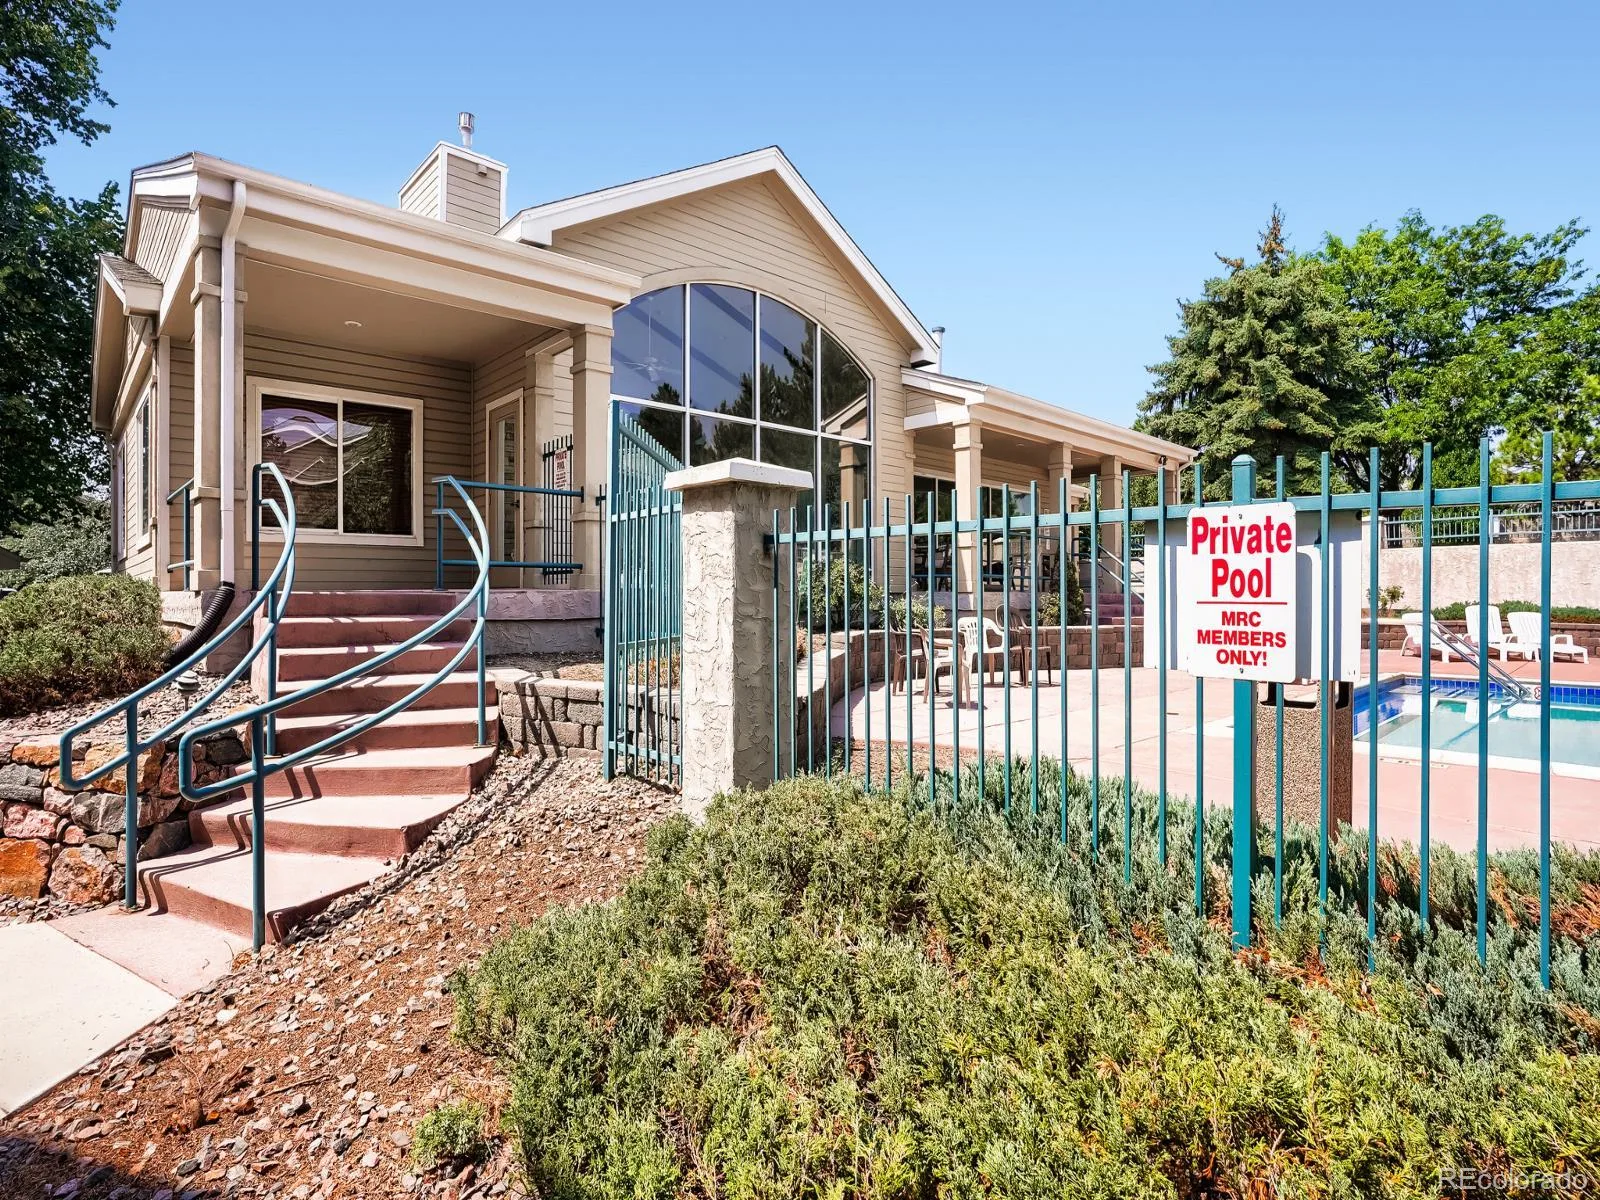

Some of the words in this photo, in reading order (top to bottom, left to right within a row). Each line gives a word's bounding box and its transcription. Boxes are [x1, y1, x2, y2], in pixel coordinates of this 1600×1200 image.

[1191, 515, 1292, 555] Private
[1211, 557, 1272, 599] Pool
[1221, 611, 1262, 627] MRC
[1197, 629, 1287, 649] MEMBERS
[1216, 649, 1268, 667] ONLY!
